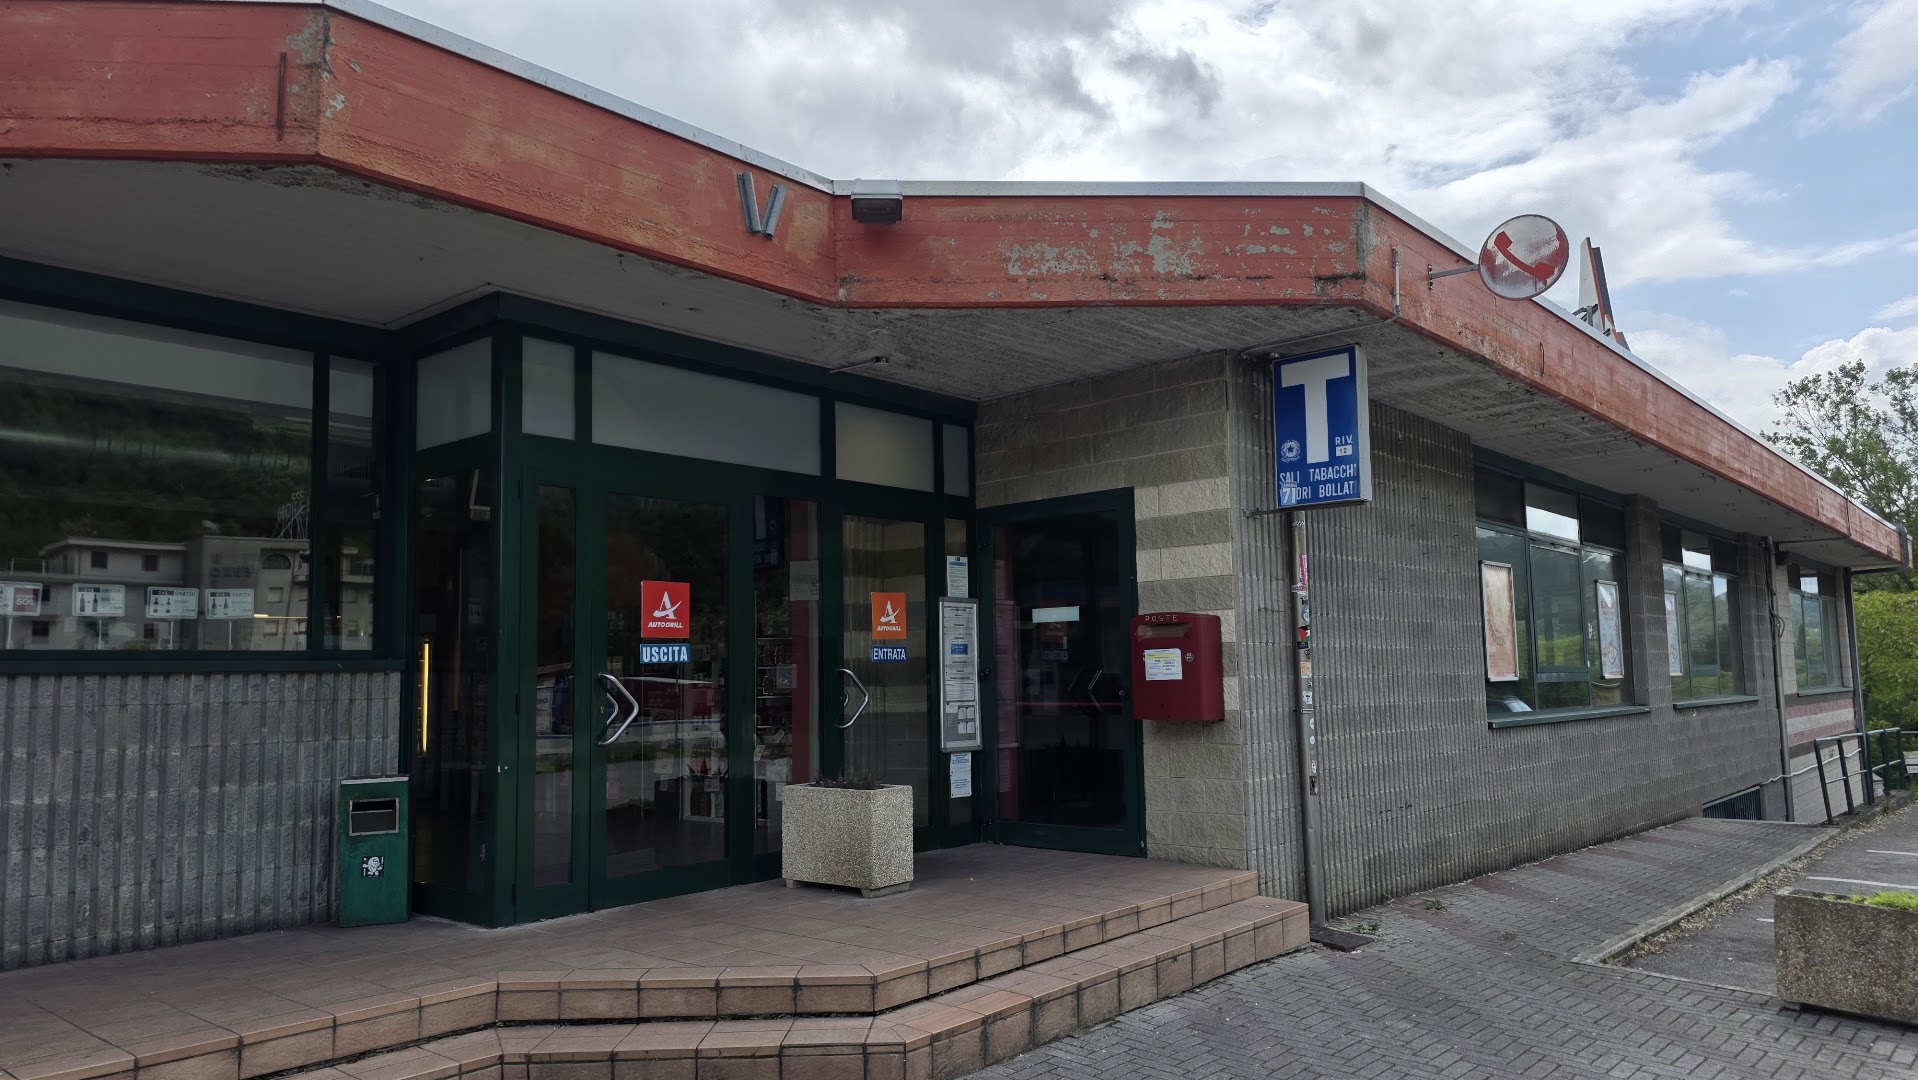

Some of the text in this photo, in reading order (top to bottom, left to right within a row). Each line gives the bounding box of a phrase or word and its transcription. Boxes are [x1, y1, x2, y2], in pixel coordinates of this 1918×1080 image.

[1281, 352, 1350, 464] T
[1335, 434, 1353, 446] RIV.
[1279, 470, 1300, 485] SALI
[1282, 487, 1297, 504] 71
[1144, 614, 1179, 622] POSTE
[647, 621, 684, 629] AUTOGRILL
[642, 646, 688, 663] USCITA
[873, 648, 907, 660] ENTRATA
